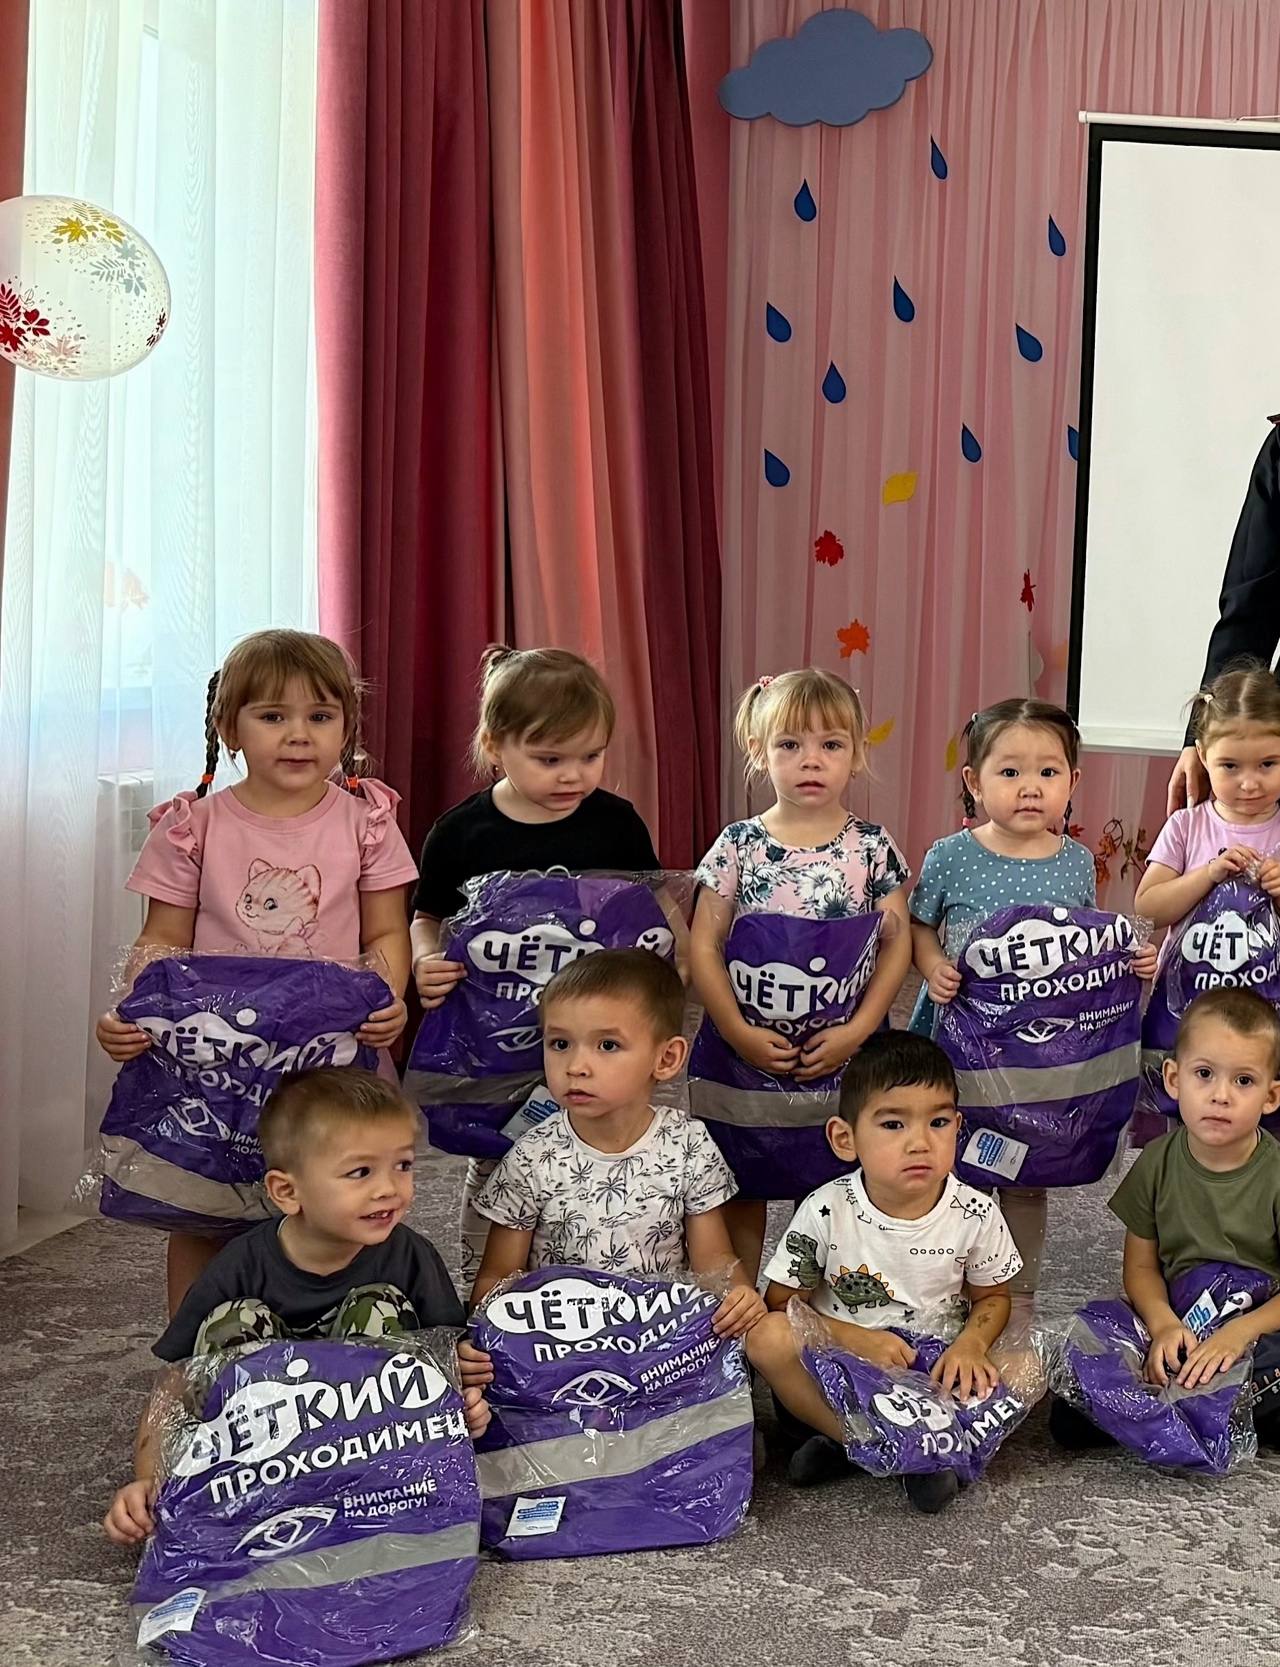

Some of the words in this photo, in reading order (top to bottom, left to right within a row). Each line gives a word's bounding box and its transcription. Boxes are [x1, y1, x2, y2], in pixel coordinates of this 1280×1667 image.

[1001, 959, 1134, 1002] ПРОХОДИМ
[1080, 1019, 1094, 1031] НА
[534, 1294, 718, 1363] ПРОХОДИМЕ
[641, 1338, 717, 1384] ВНИМАНИЕ
[645, 1381, 662, 1394] НА
[664, 1354, 711, 1386] ДОРОГУ!
[192, 1357, 428, 1465] ЧЁТКИЙ
[210, 1409, 470, 1503] ПРОХОДИМЕЦ
[343, 1479, 437, 1508] ВНИМАНИЕ
[344, 1509, 363, 1518] НА
[367, 1497, 428, 1517] ДОРОГУ!
